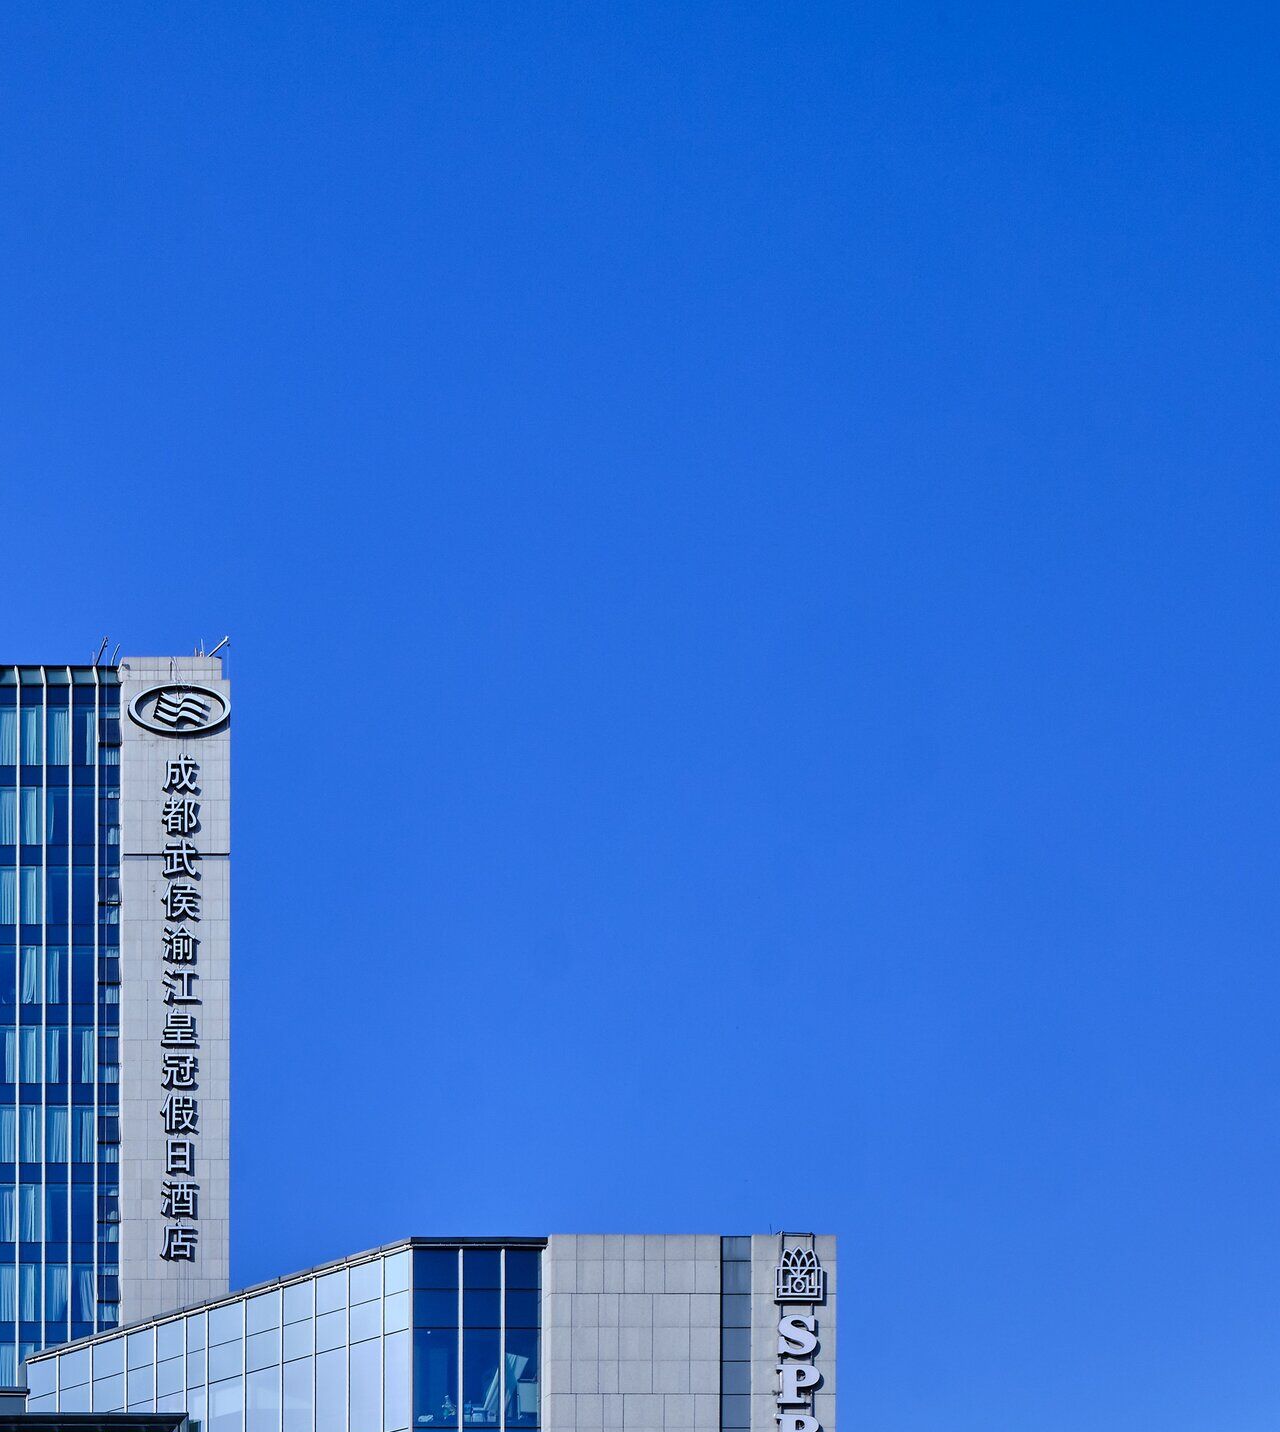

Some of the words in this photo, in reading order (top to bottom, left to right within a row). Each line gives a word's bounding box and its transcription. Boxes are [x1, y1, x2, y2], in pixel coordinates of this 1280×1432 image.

[160, 753, 199, 1260] 成都武侯渝江皇冠假日酒店
